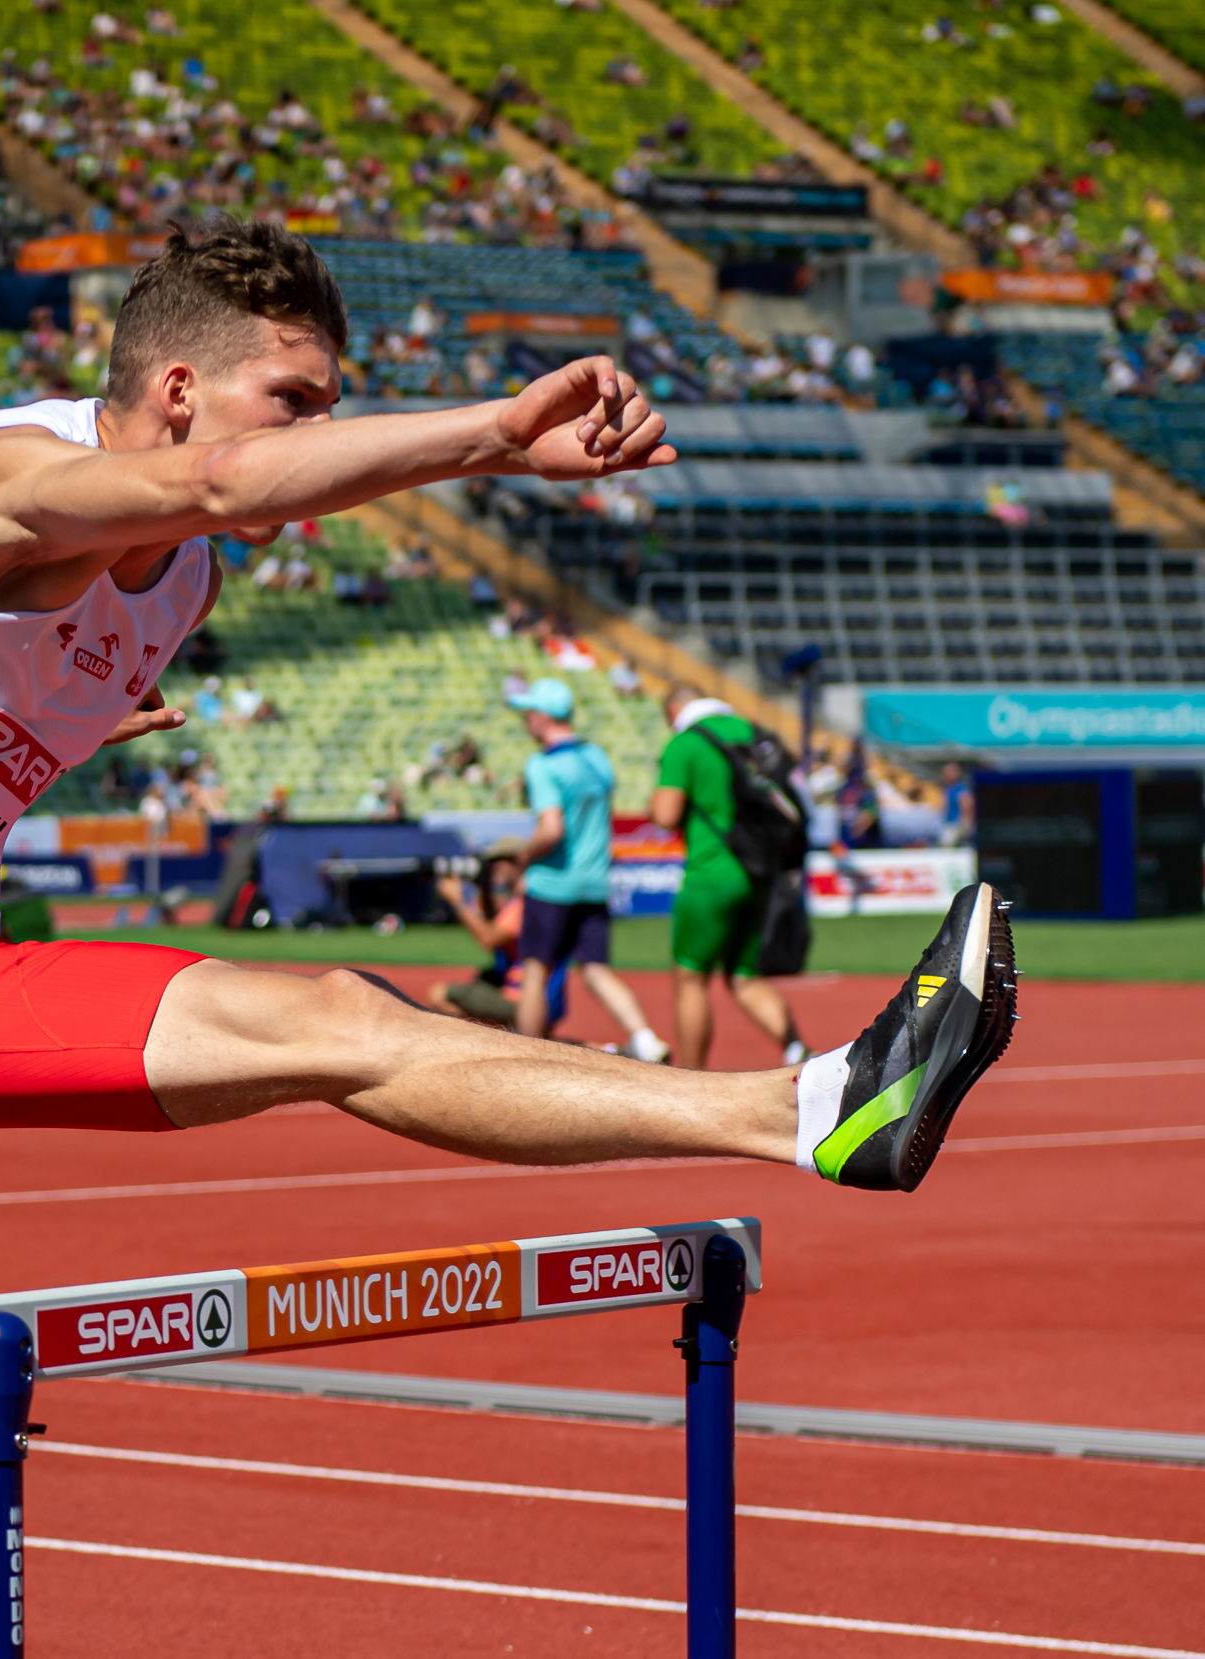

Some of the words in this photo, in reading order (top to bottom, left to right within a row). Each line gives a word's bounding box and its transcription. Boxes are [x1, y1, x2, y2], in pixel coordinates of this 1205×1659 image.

[76, 650, 110, 678] ORLEN
[569, 1249, 661, 1294] SPAR
[267, 1270, 408, 1337] MUNICH
[421, 1260, 503, 1318] 2022
[77, 1302, 191, 1355] SPAR
[6, 1528, 24, 1646] MONDO
